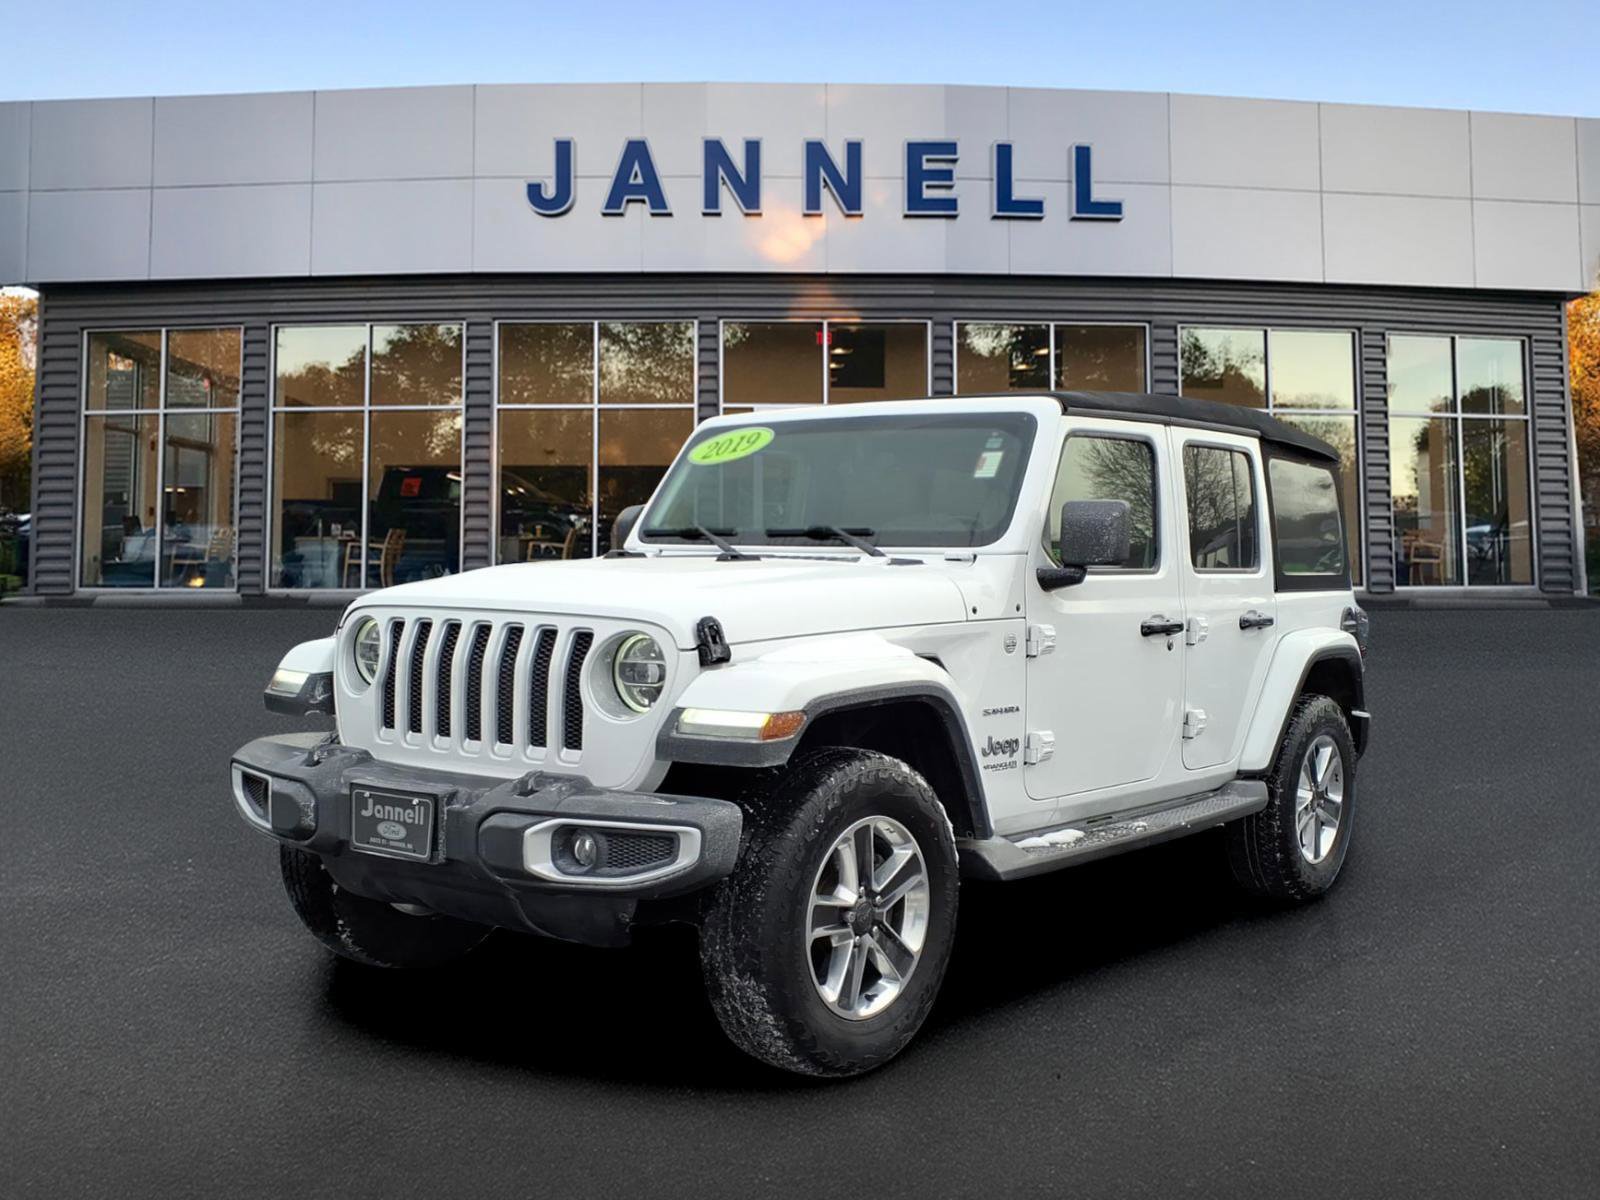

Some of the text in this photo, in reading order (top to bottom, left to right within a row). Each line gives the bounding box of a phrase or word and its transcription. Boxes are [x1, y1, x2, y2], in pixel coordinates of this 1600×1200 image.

[526, 137, 1123, 218] JANNELL
[701, 431, 762, 460] 2019
[982, 705, 1020, 717] SAHARA
[981, 735, 1020, 758] Jeep
[360, 798, 424, 826] Jannell
